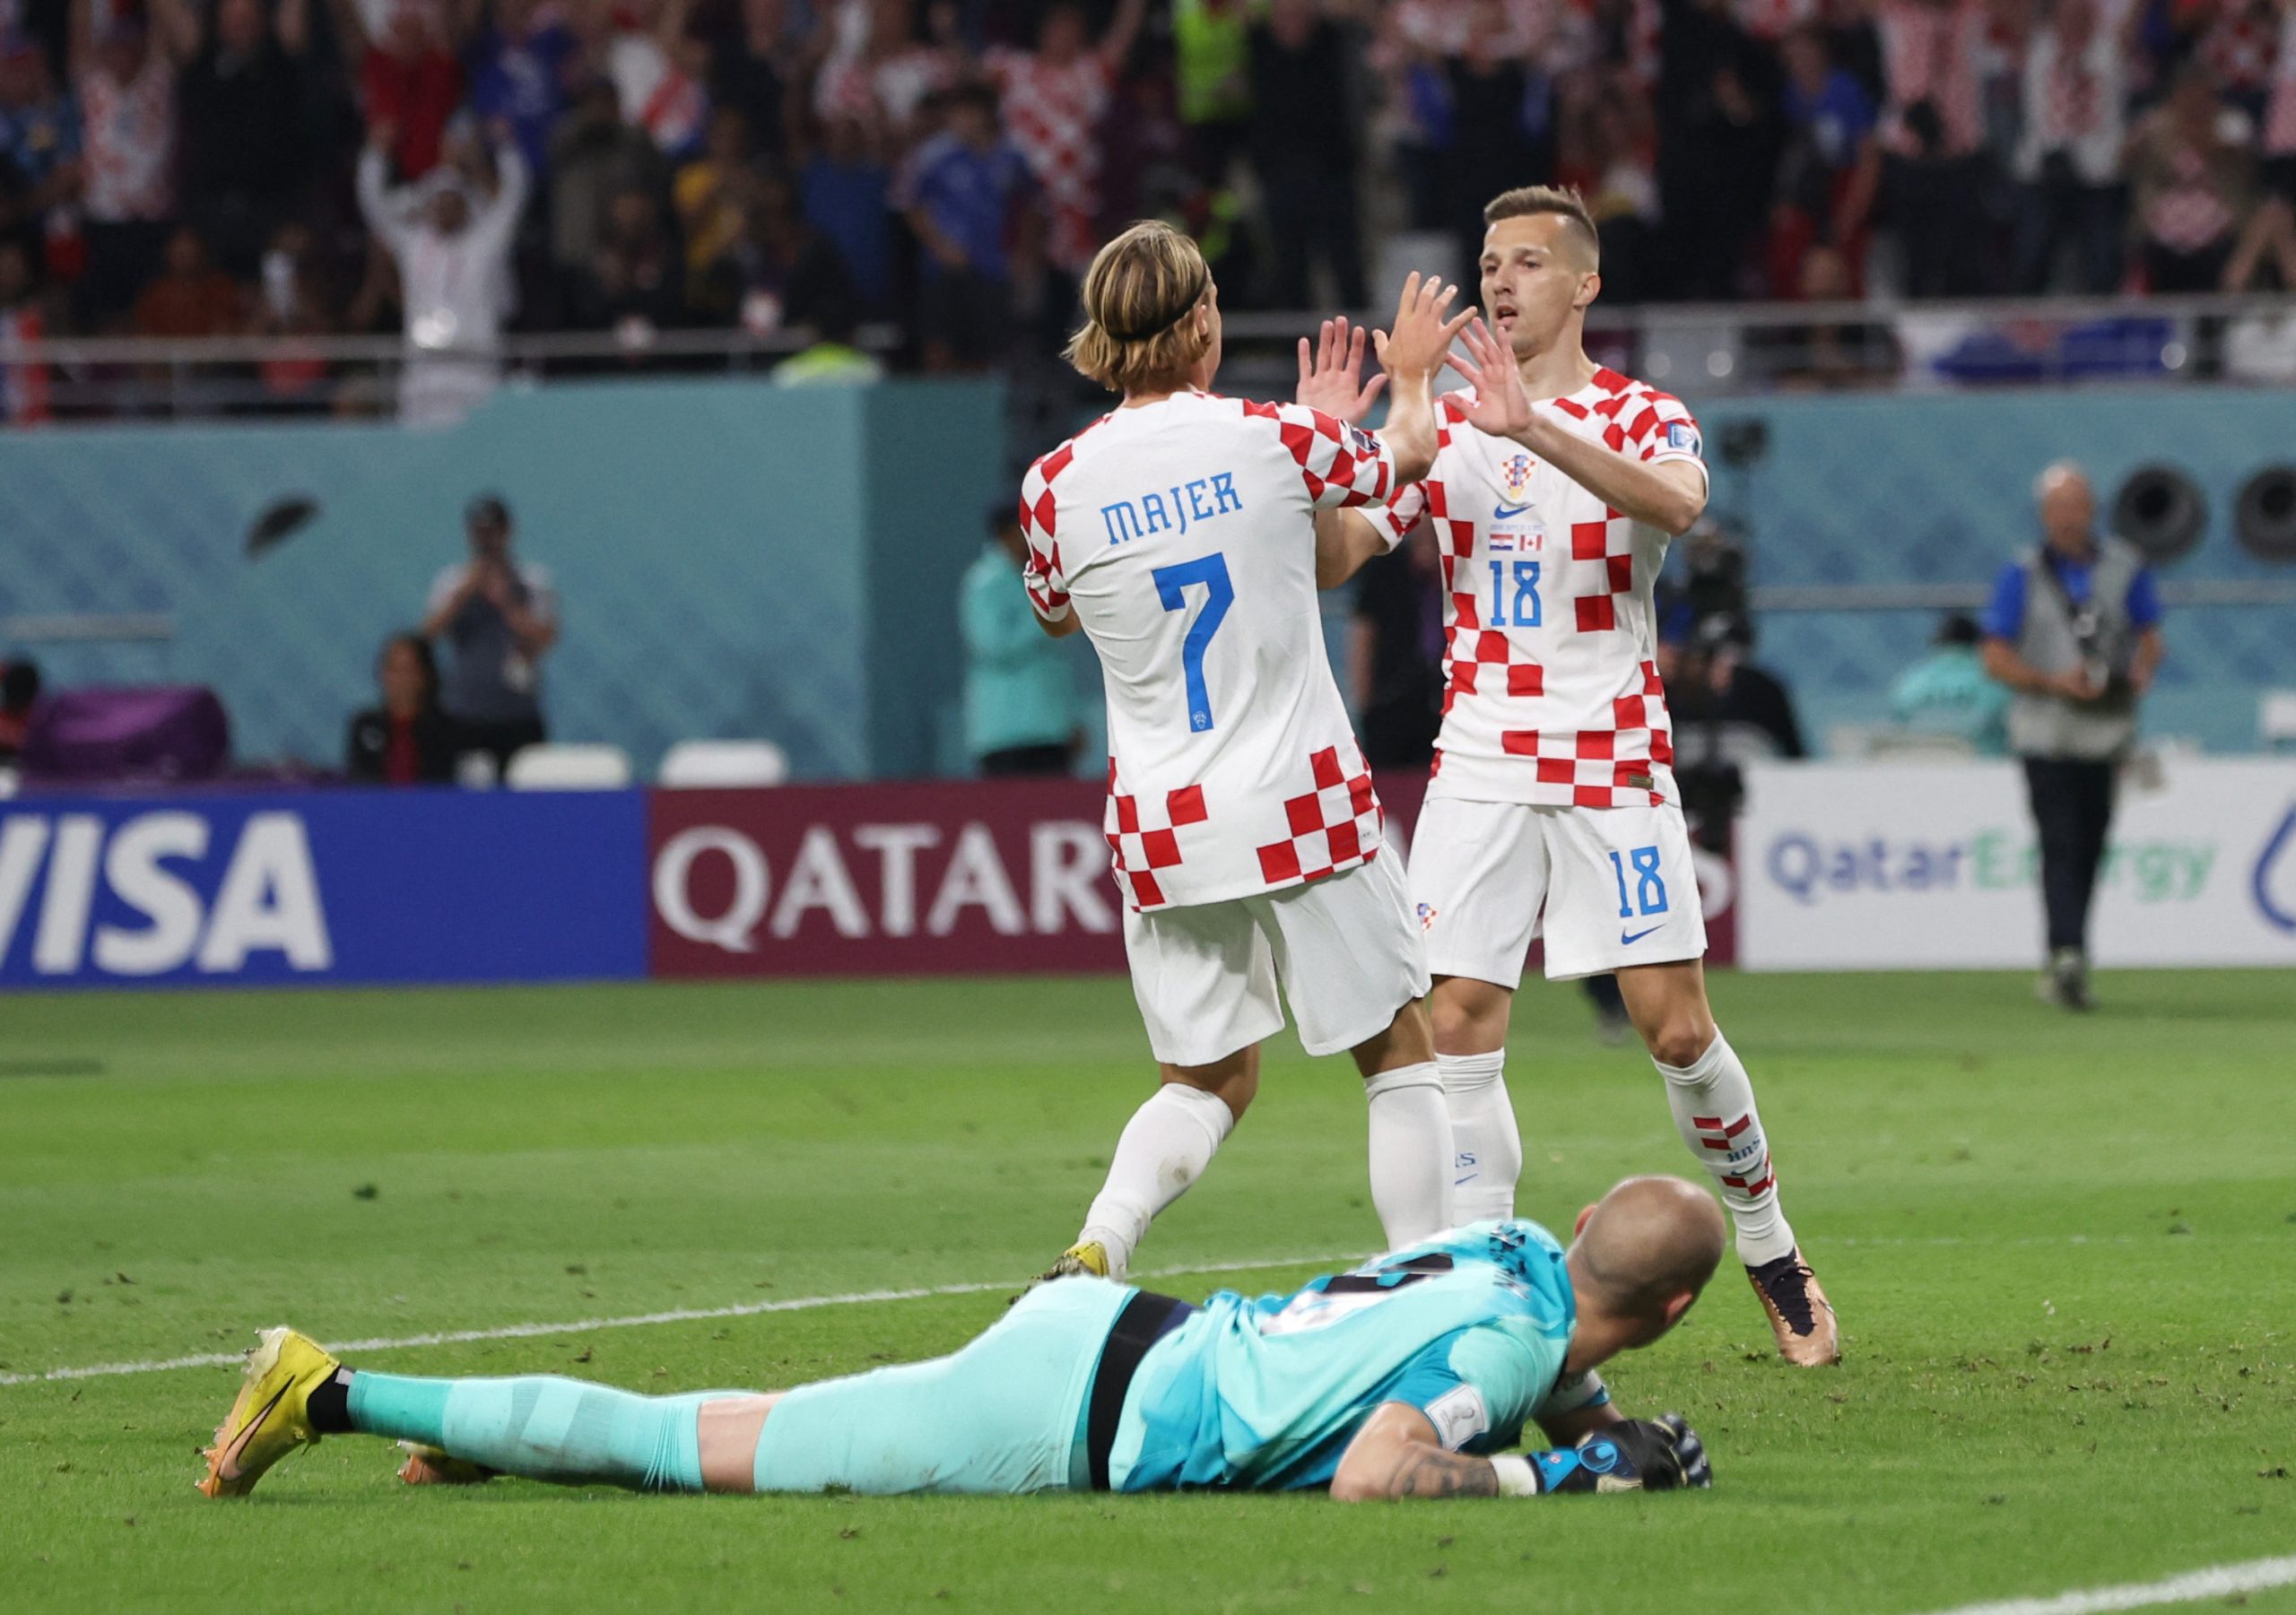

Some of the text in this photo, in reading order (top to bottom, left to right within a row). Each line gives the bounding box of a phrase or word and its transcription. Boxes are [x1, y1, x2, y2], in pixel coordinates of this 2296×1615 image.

[1100, 472, 1243, 545] MAJER
[1489, 560, 1542, 628] 18
[1152, 551, 1235, 734] 7
[652, 820, 1118, 953] QATAR
[1609, 846, 1668, 918] 18
[1765, 826, 2218, 907] QatarErgy
